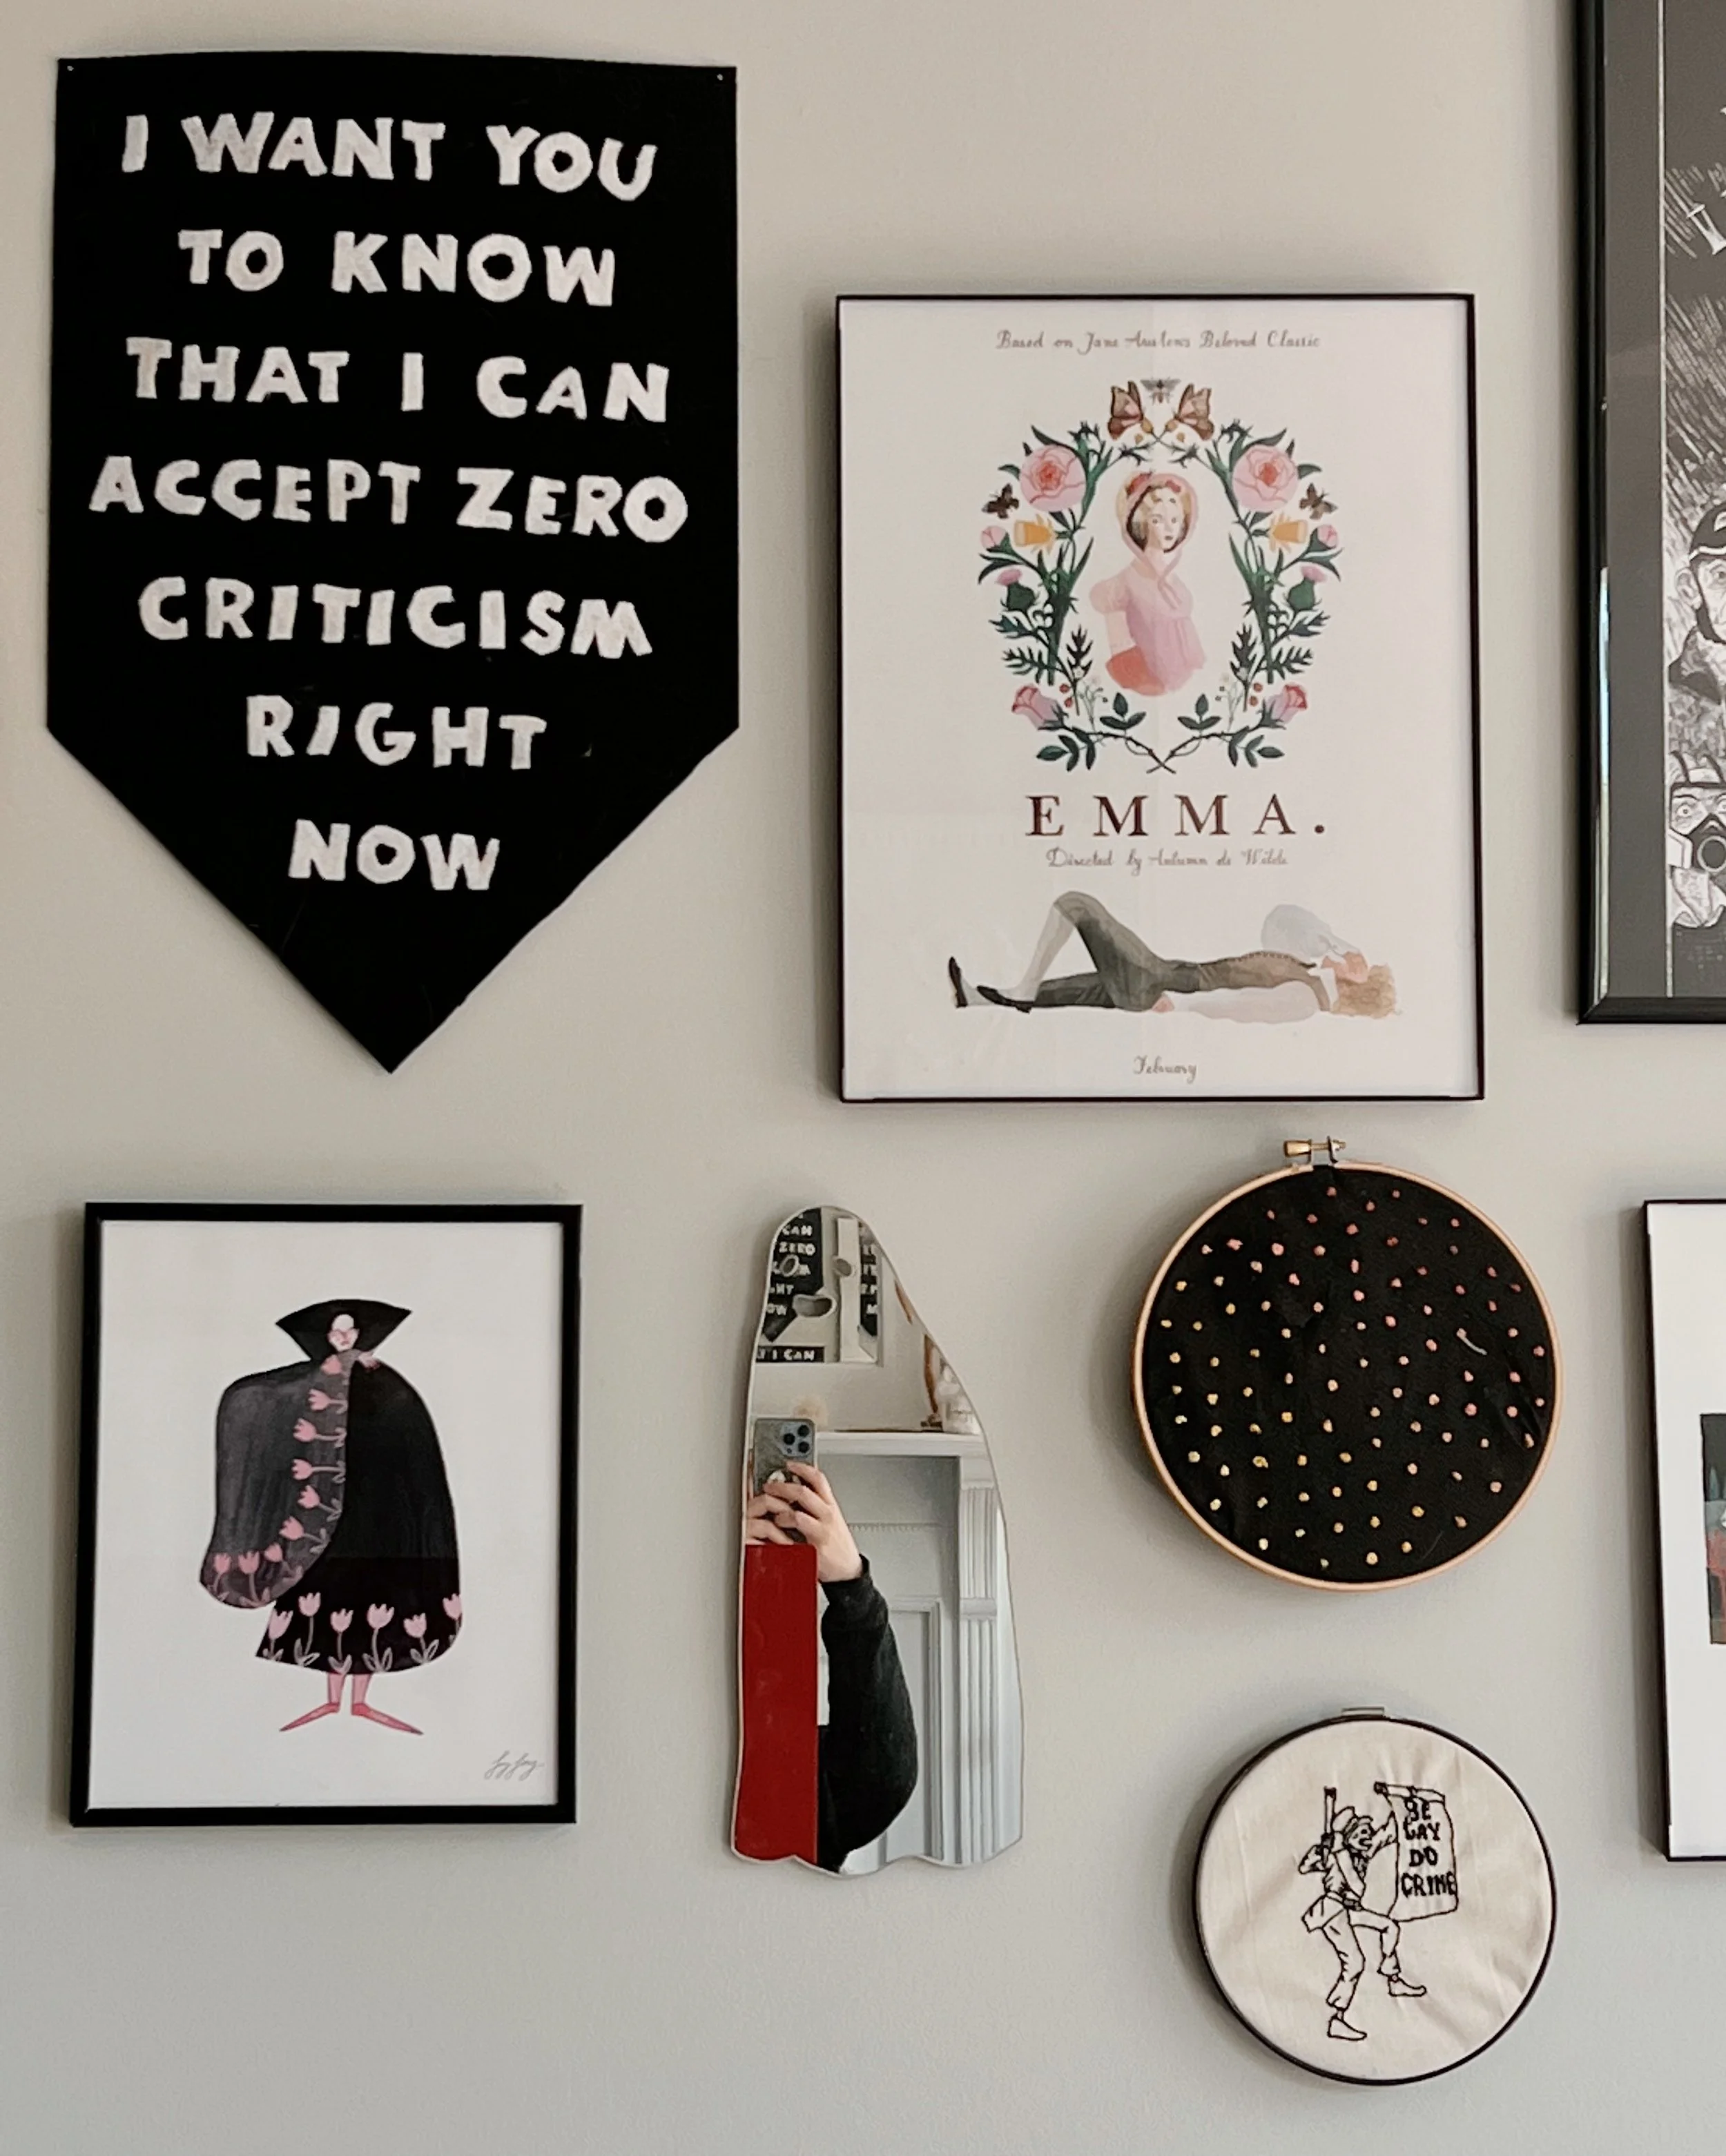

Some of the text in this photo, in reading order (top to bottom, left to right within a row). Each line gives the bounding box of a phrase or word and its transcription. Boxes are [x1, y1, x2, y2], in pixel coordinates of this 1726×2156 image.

[123, 112, 657, 200] I WANT YOU
[178, 229, 614, 306] TO KNOW
[995, 329, 1045, 349] Based
[1053, 338, 1074, 349] on
[1077, 331, 1119, 356] Jane
[1267, 329, 1320, 348] Classic
[127, 338, 669, 422] THAT I CAN
[90, 456, 688, 542] ACCEPT ZERO
[139, 576, 652, 659] CRITICISM
[247, 695, 546, 769] RIGHT
[1025, 793, 1326, 837] EMMA.
[289, 819, 499, 890] NOW
[1046, 846, 1114, 868] Directed
[1125, 848, 1143, 877] by
[779, 1241, 816, 1256] ZERO
[1404, 1798, 1432, 1822] BE
[1409, 1846, 1438, 1867] DO
